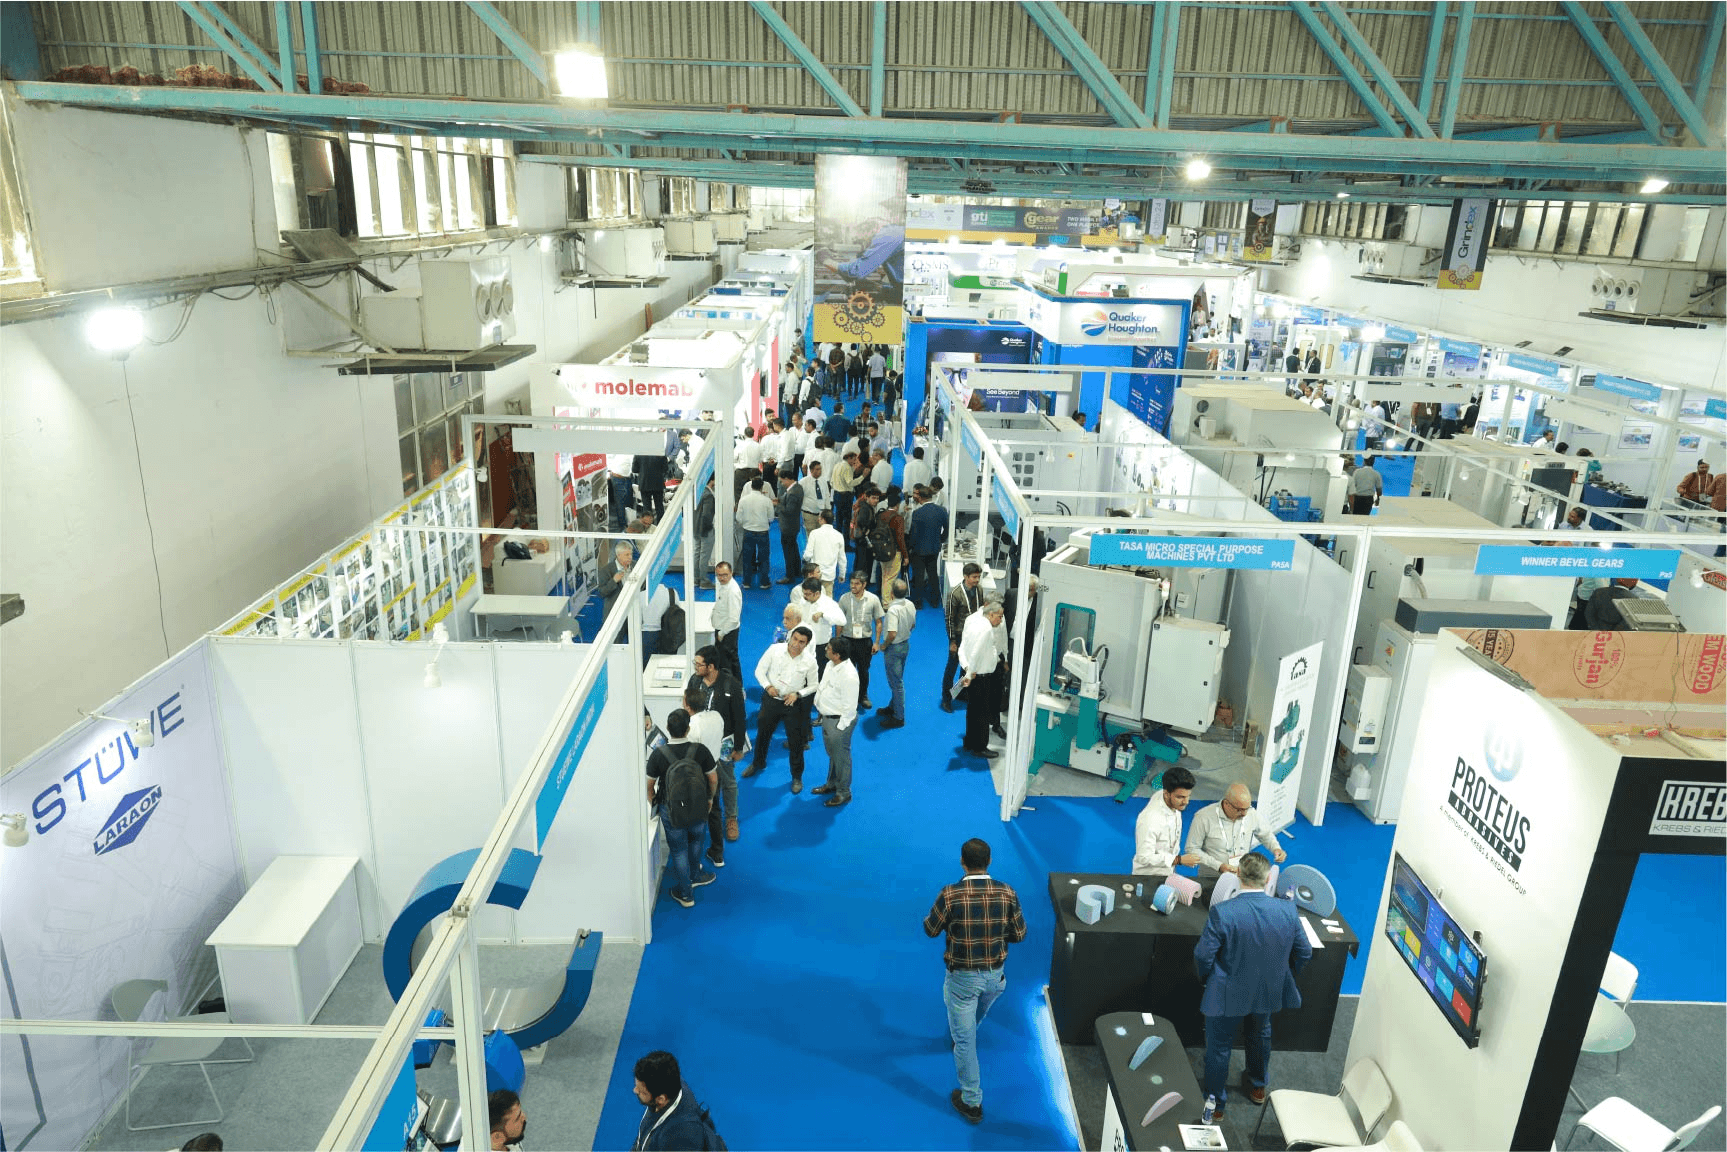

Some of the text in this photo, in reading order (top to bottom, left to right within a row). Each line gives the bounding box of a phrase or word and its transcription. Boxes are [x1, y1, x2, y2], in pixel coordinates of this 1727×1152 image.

[1458, 206, 1477, 258] Grindex
[1109, 311, 1147, 323] Quaker
[1108, 323, 1158, 335] Houghton
[595, 379, 693, 396] molemab
[1119, 541, 1264, 554] TASA MICRO SPECIAL PURPOSE
[1146, 551, 1235, 562] MACHINES PVT LTD
[1521, 556, 1625, 568] WINNER BEVEL GEARS
[1452, 756, 1530, 854] PROTEUS
[93, 786, 162, 855] LARAON
[1653, 824, 1691, 833] KREBS
[1454, 798, 1514, 863] ABRASIVES
[1507, 873, 1527, 896] GROUP
[403, 1103, 417, 1140] A15
